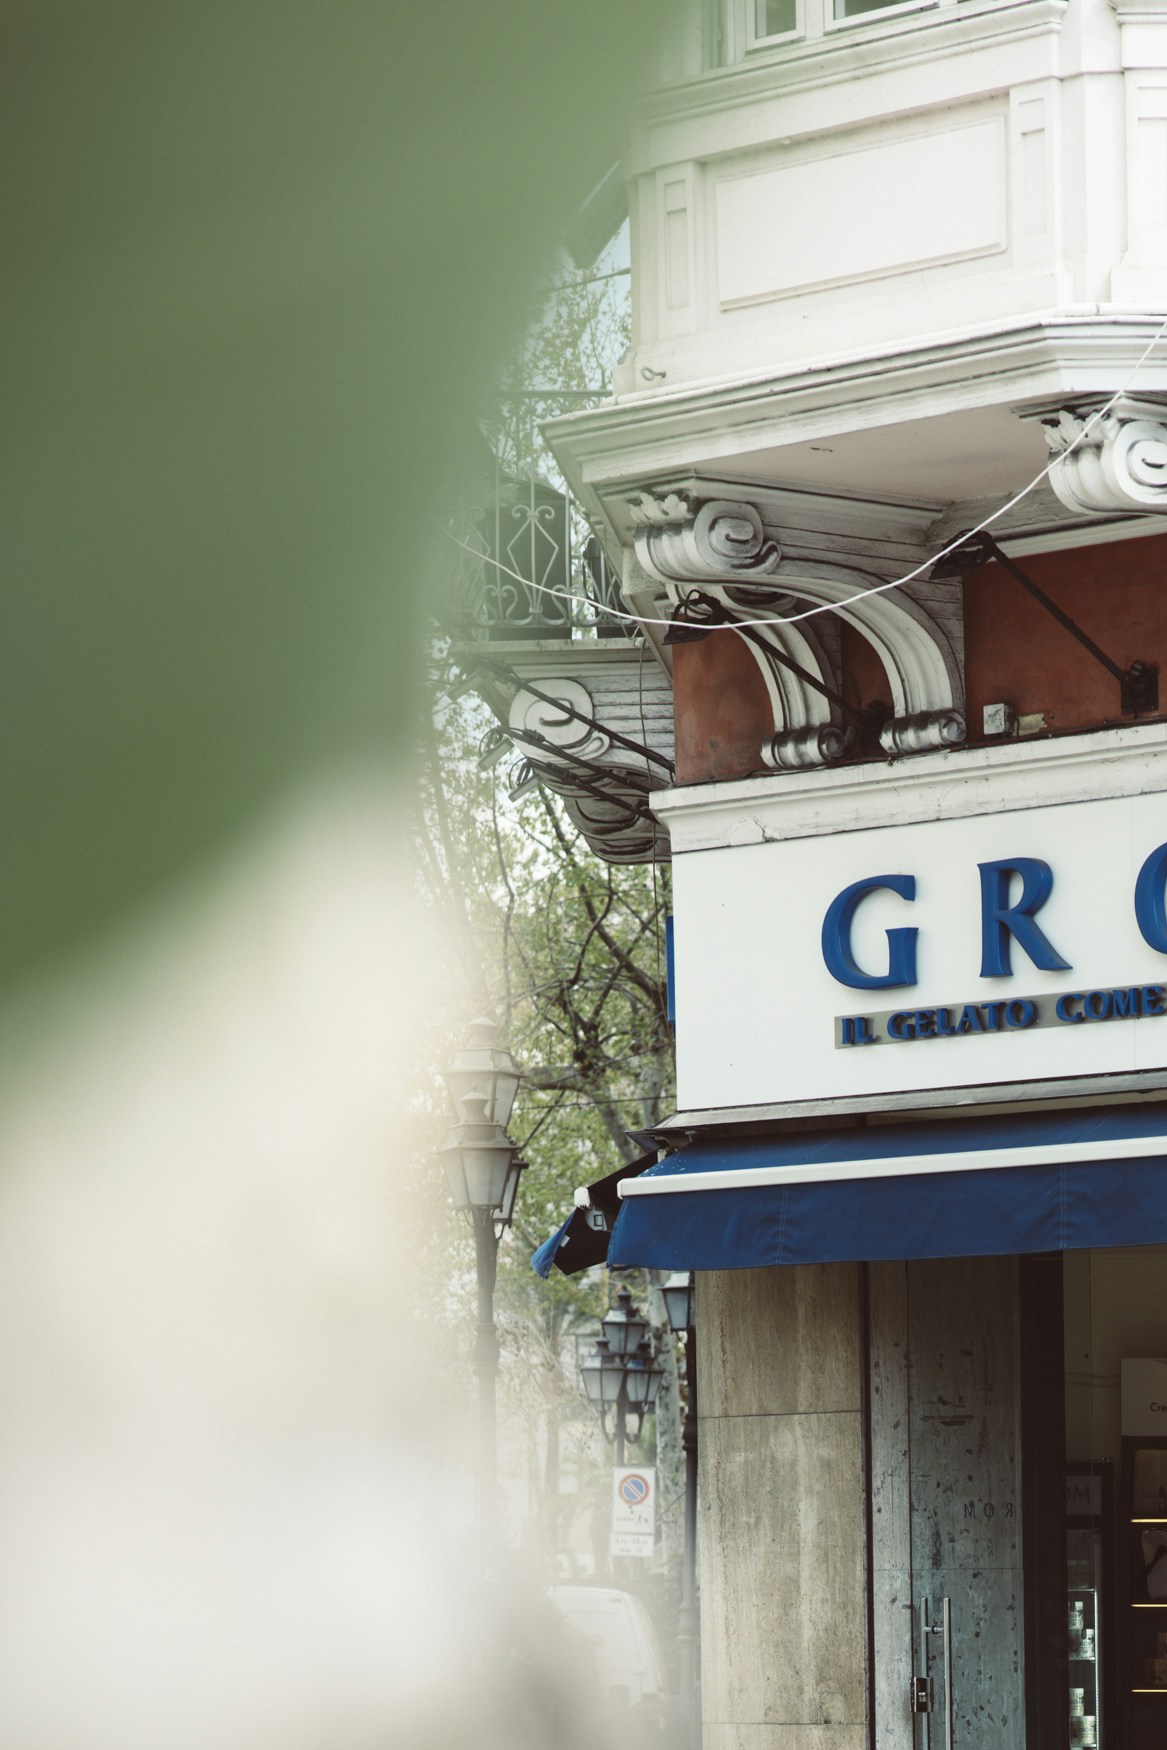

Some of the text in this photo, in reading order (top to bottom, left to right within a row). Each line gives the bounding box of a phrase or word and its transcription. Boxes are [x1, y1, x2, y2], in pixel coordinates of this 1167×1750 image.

[841, 1016, 877, 1045] IL
[887, 999, 1036, 1040] GELATO
[1055, 985, 1165, 1022] COME
